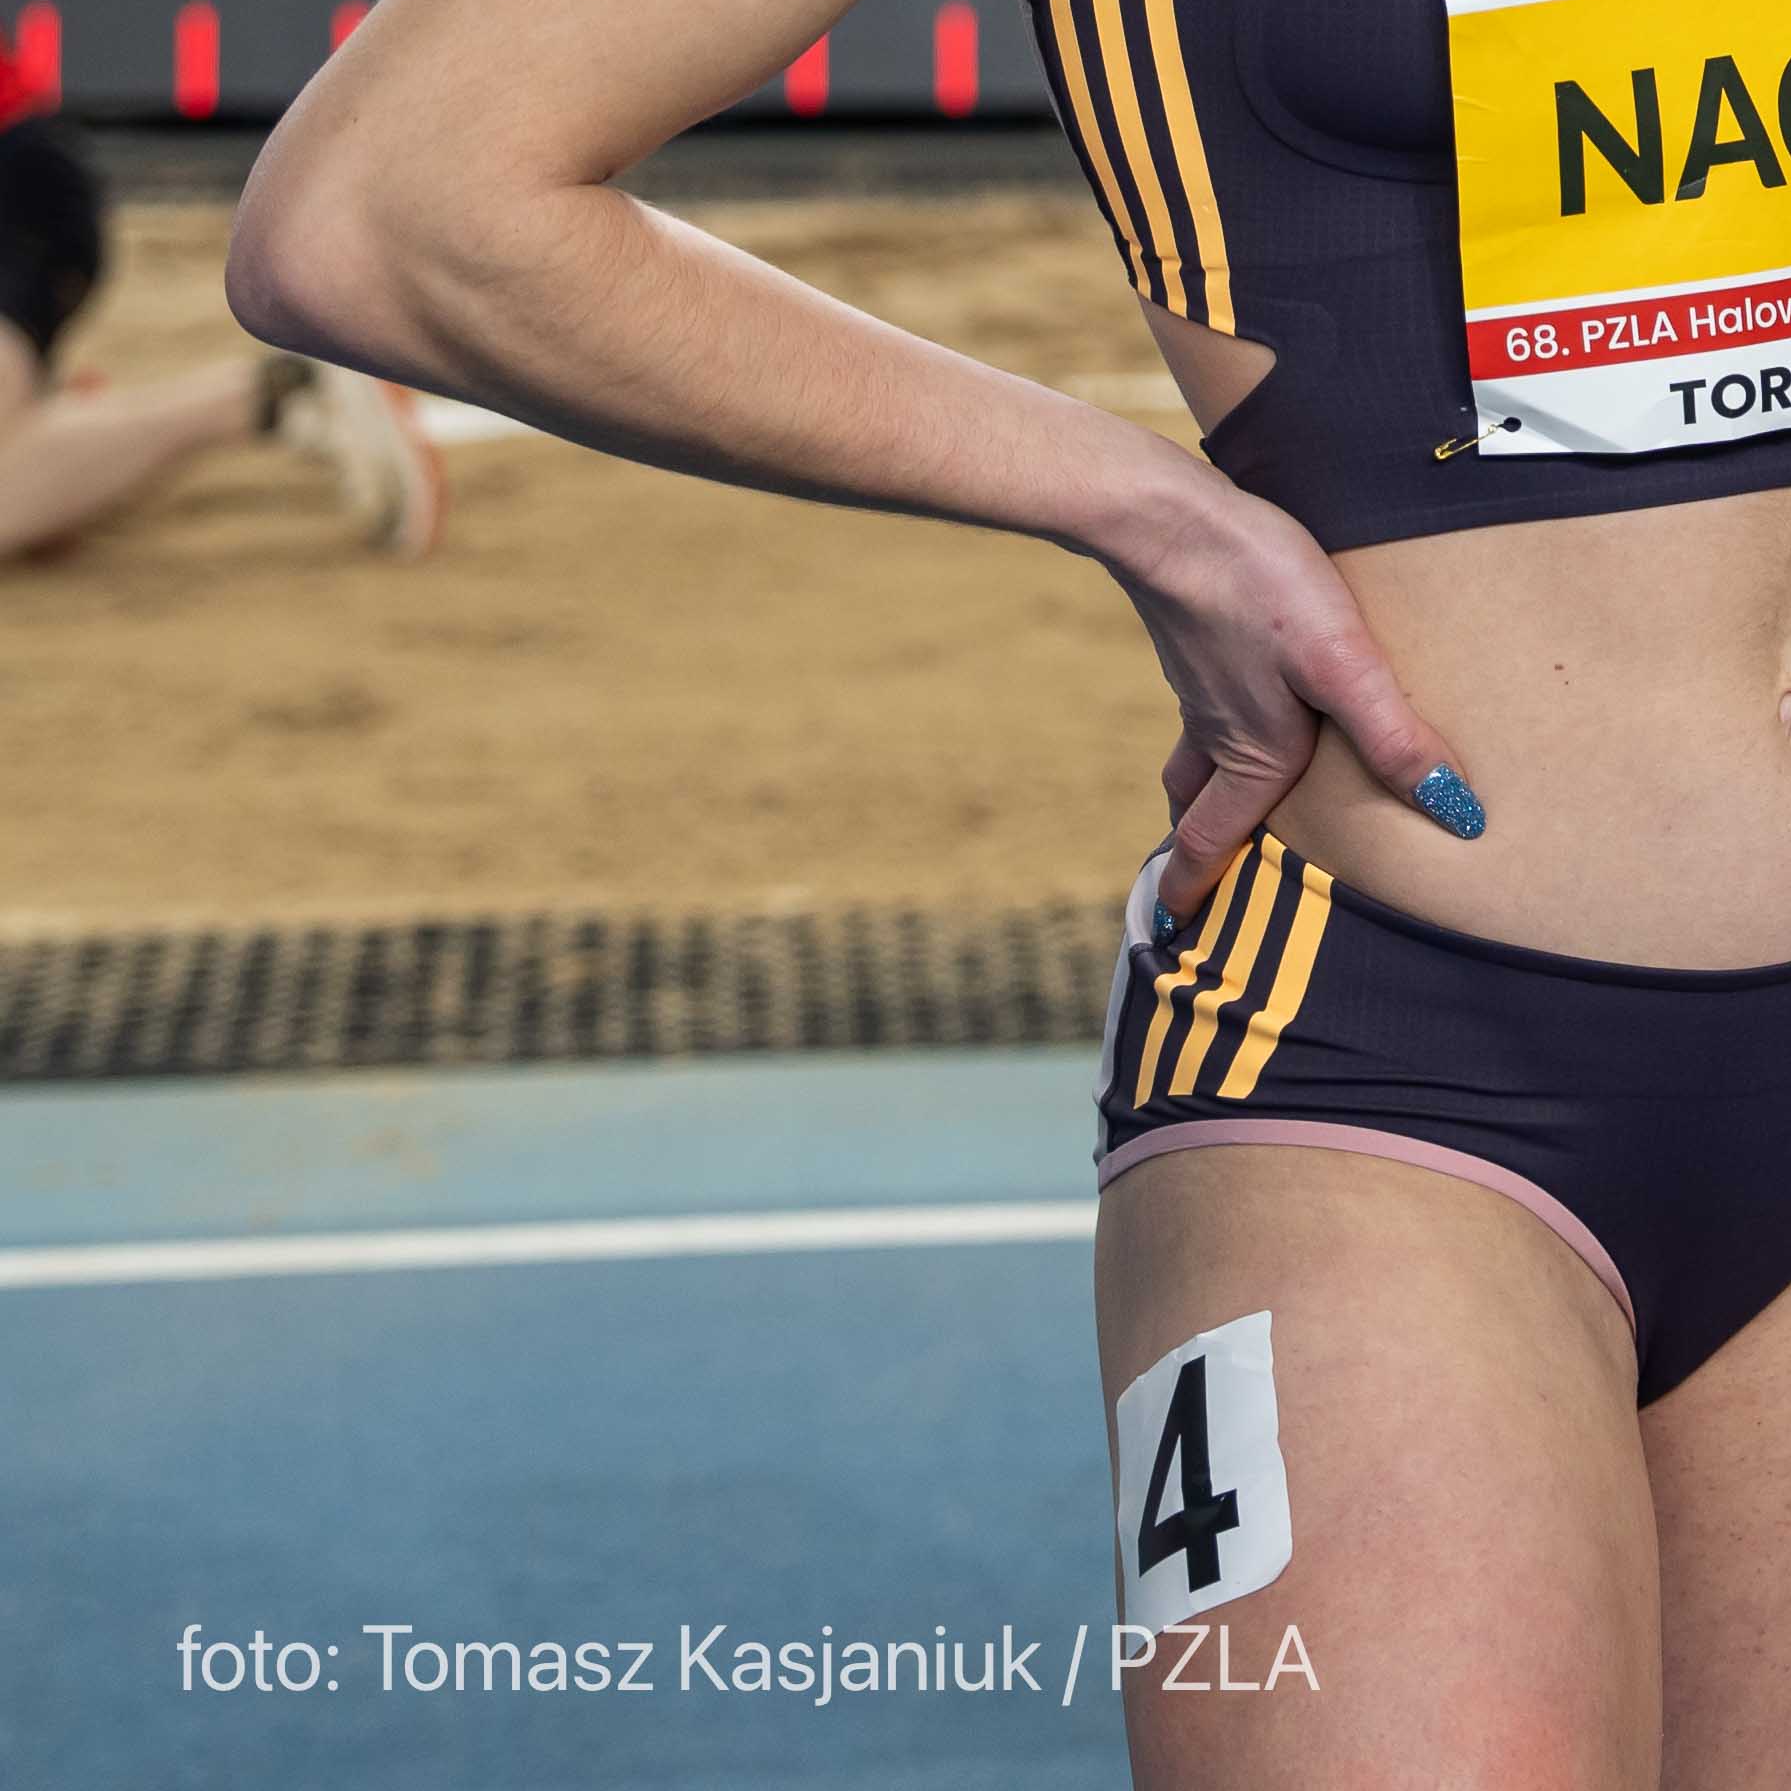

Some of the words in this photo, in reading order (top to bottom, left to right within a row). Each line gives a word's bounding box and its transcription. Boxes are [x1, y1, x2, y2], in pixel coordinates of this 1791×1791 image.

[1506, 324, 1570, 363] 68.
[1582, 314, 1676, 354] PZLA
[1136, 1353, 1241, 1594] 4
